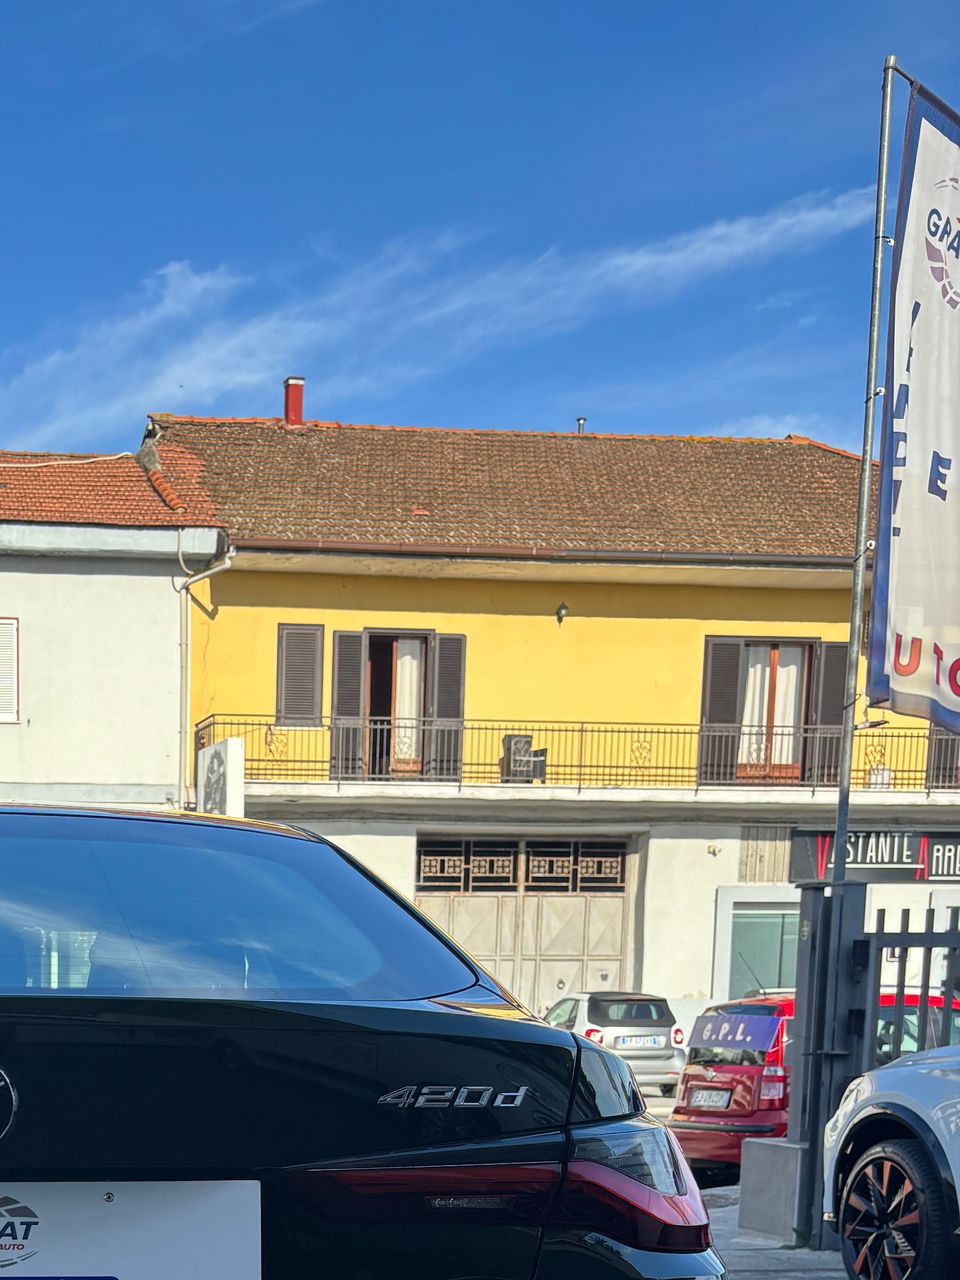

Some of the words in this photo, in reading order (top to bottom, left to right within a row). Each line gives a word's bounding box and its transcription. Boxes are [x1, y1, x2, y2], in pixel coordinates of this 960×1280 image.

[817, 832, 913, 880] VSTANTE
[702, 1022, 753, 1041] G.P.L.
[377, 1085, 529, 1108] 420d
